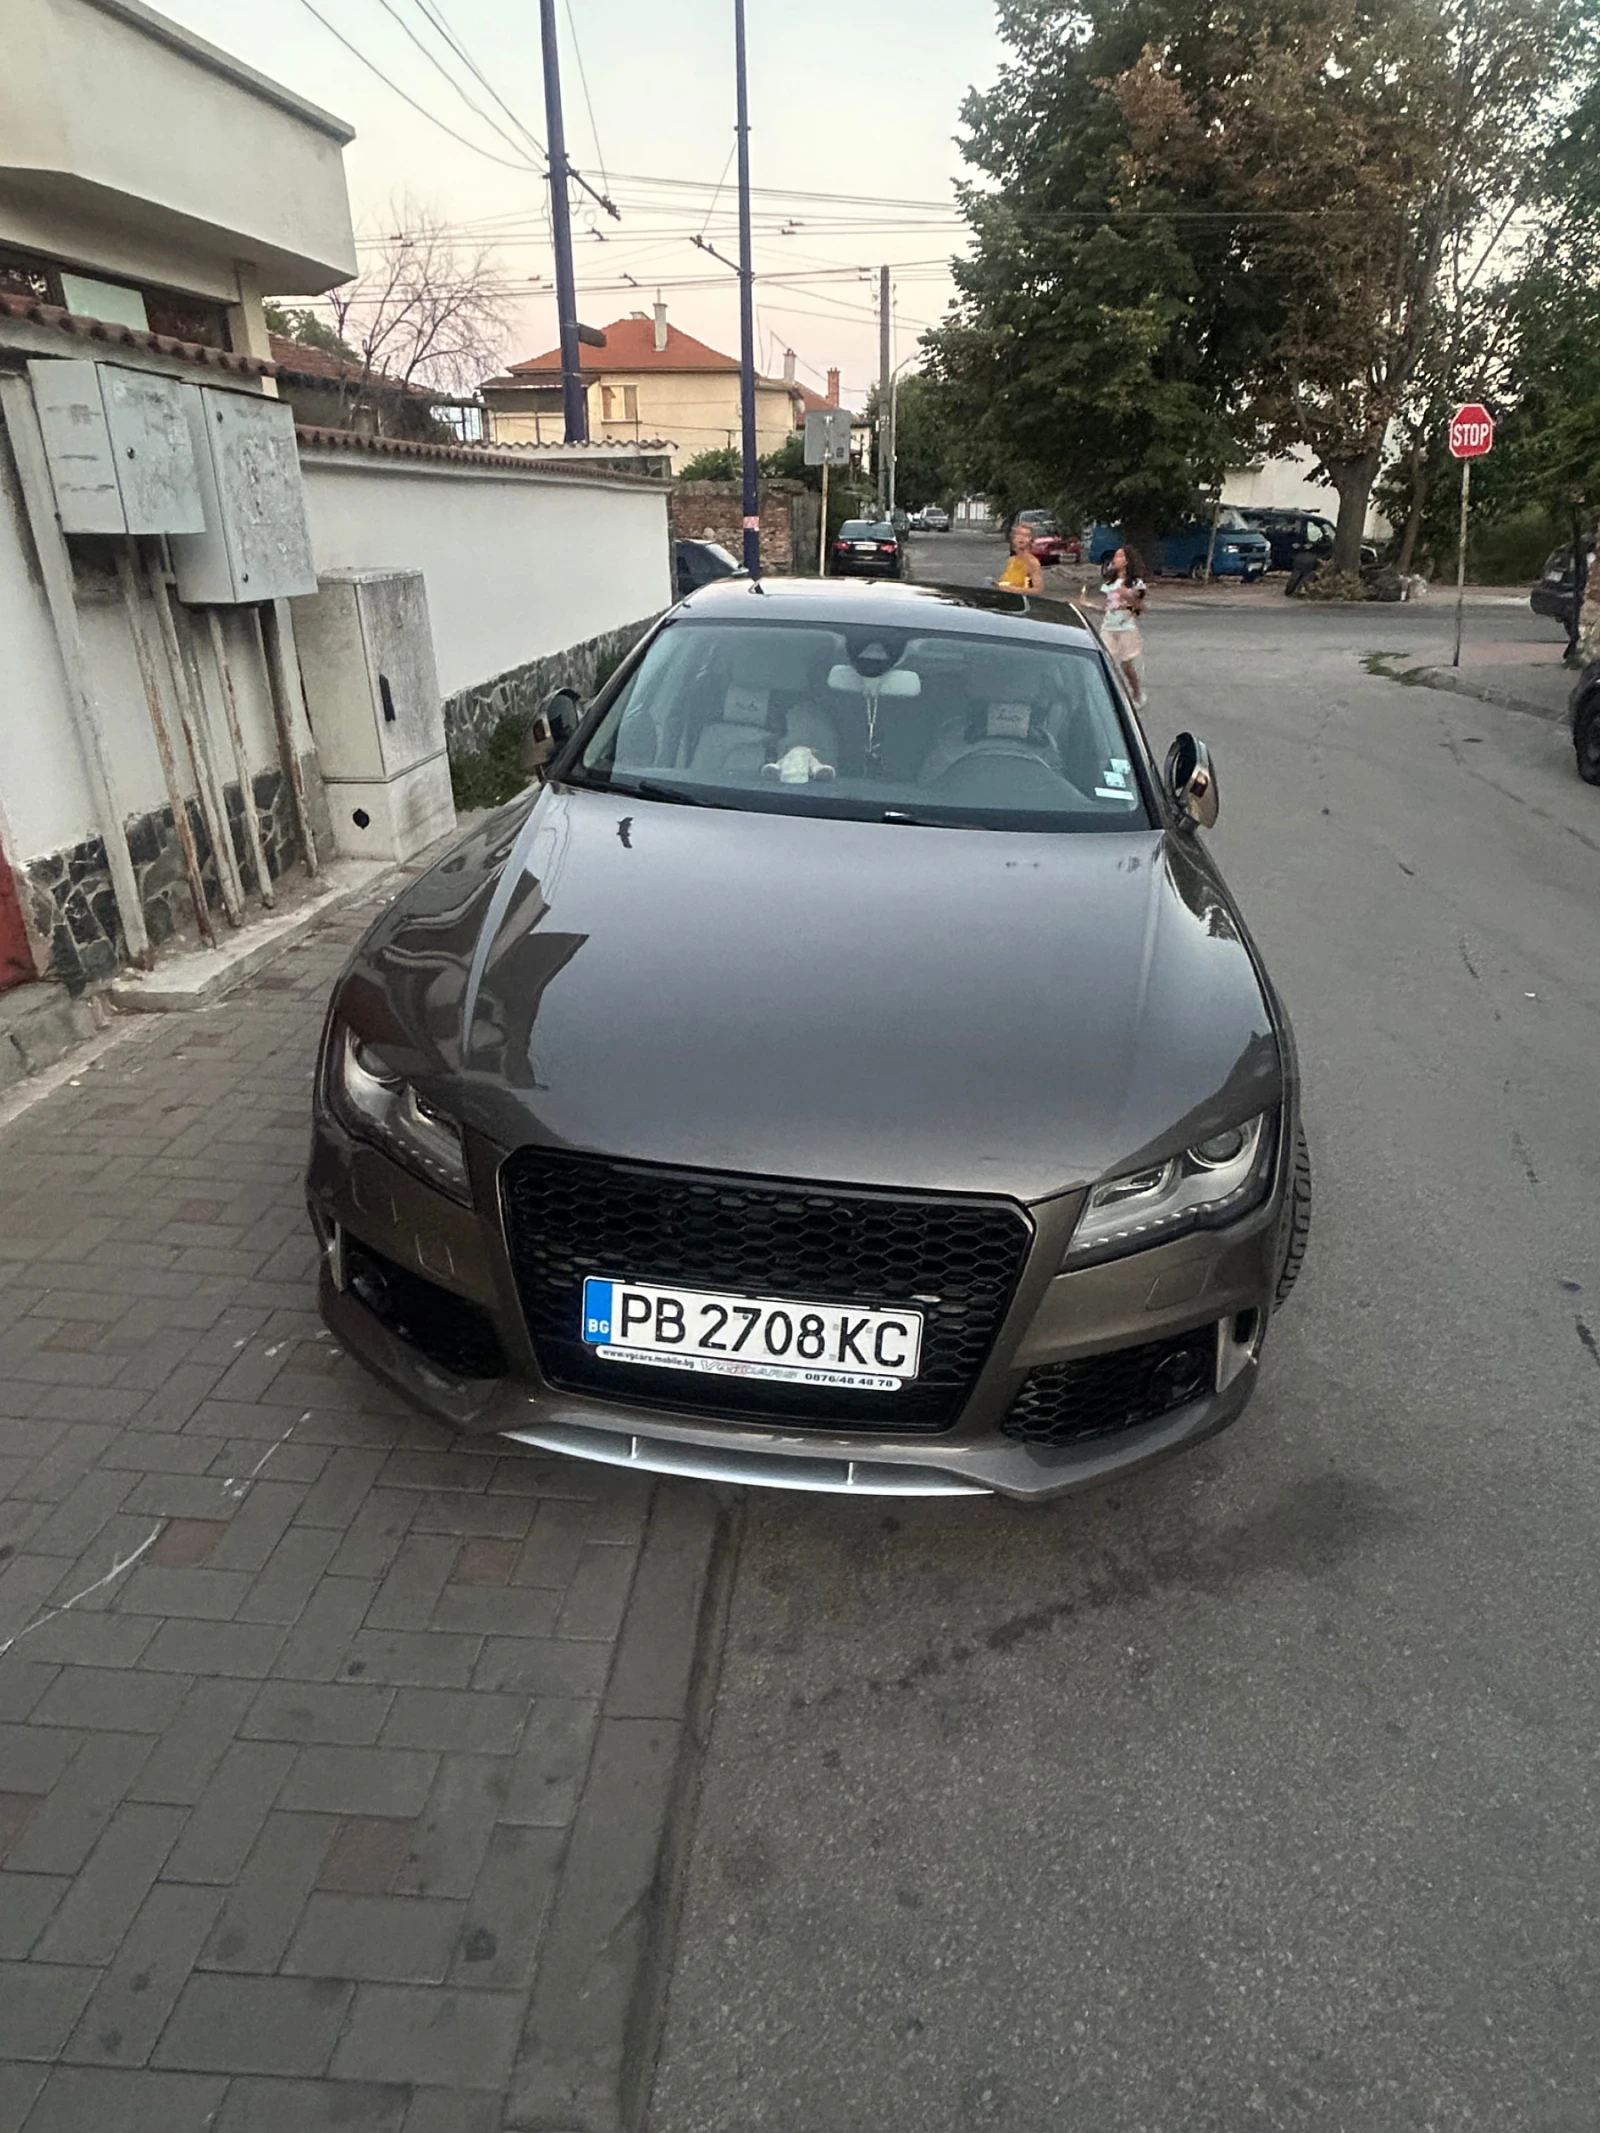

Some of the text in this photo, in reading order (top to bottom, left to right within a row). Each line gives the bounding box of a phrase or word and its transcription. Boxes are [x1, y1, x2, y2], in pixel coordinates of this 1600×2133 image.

[1453, 423, 1489, 447] STOP
[588, 1318, 610, 1334] BG
[621, 1292, 908, 1368] PB 2708 KC
[602, 1349, 695, 1369] www.vgcars.mobile.bg
